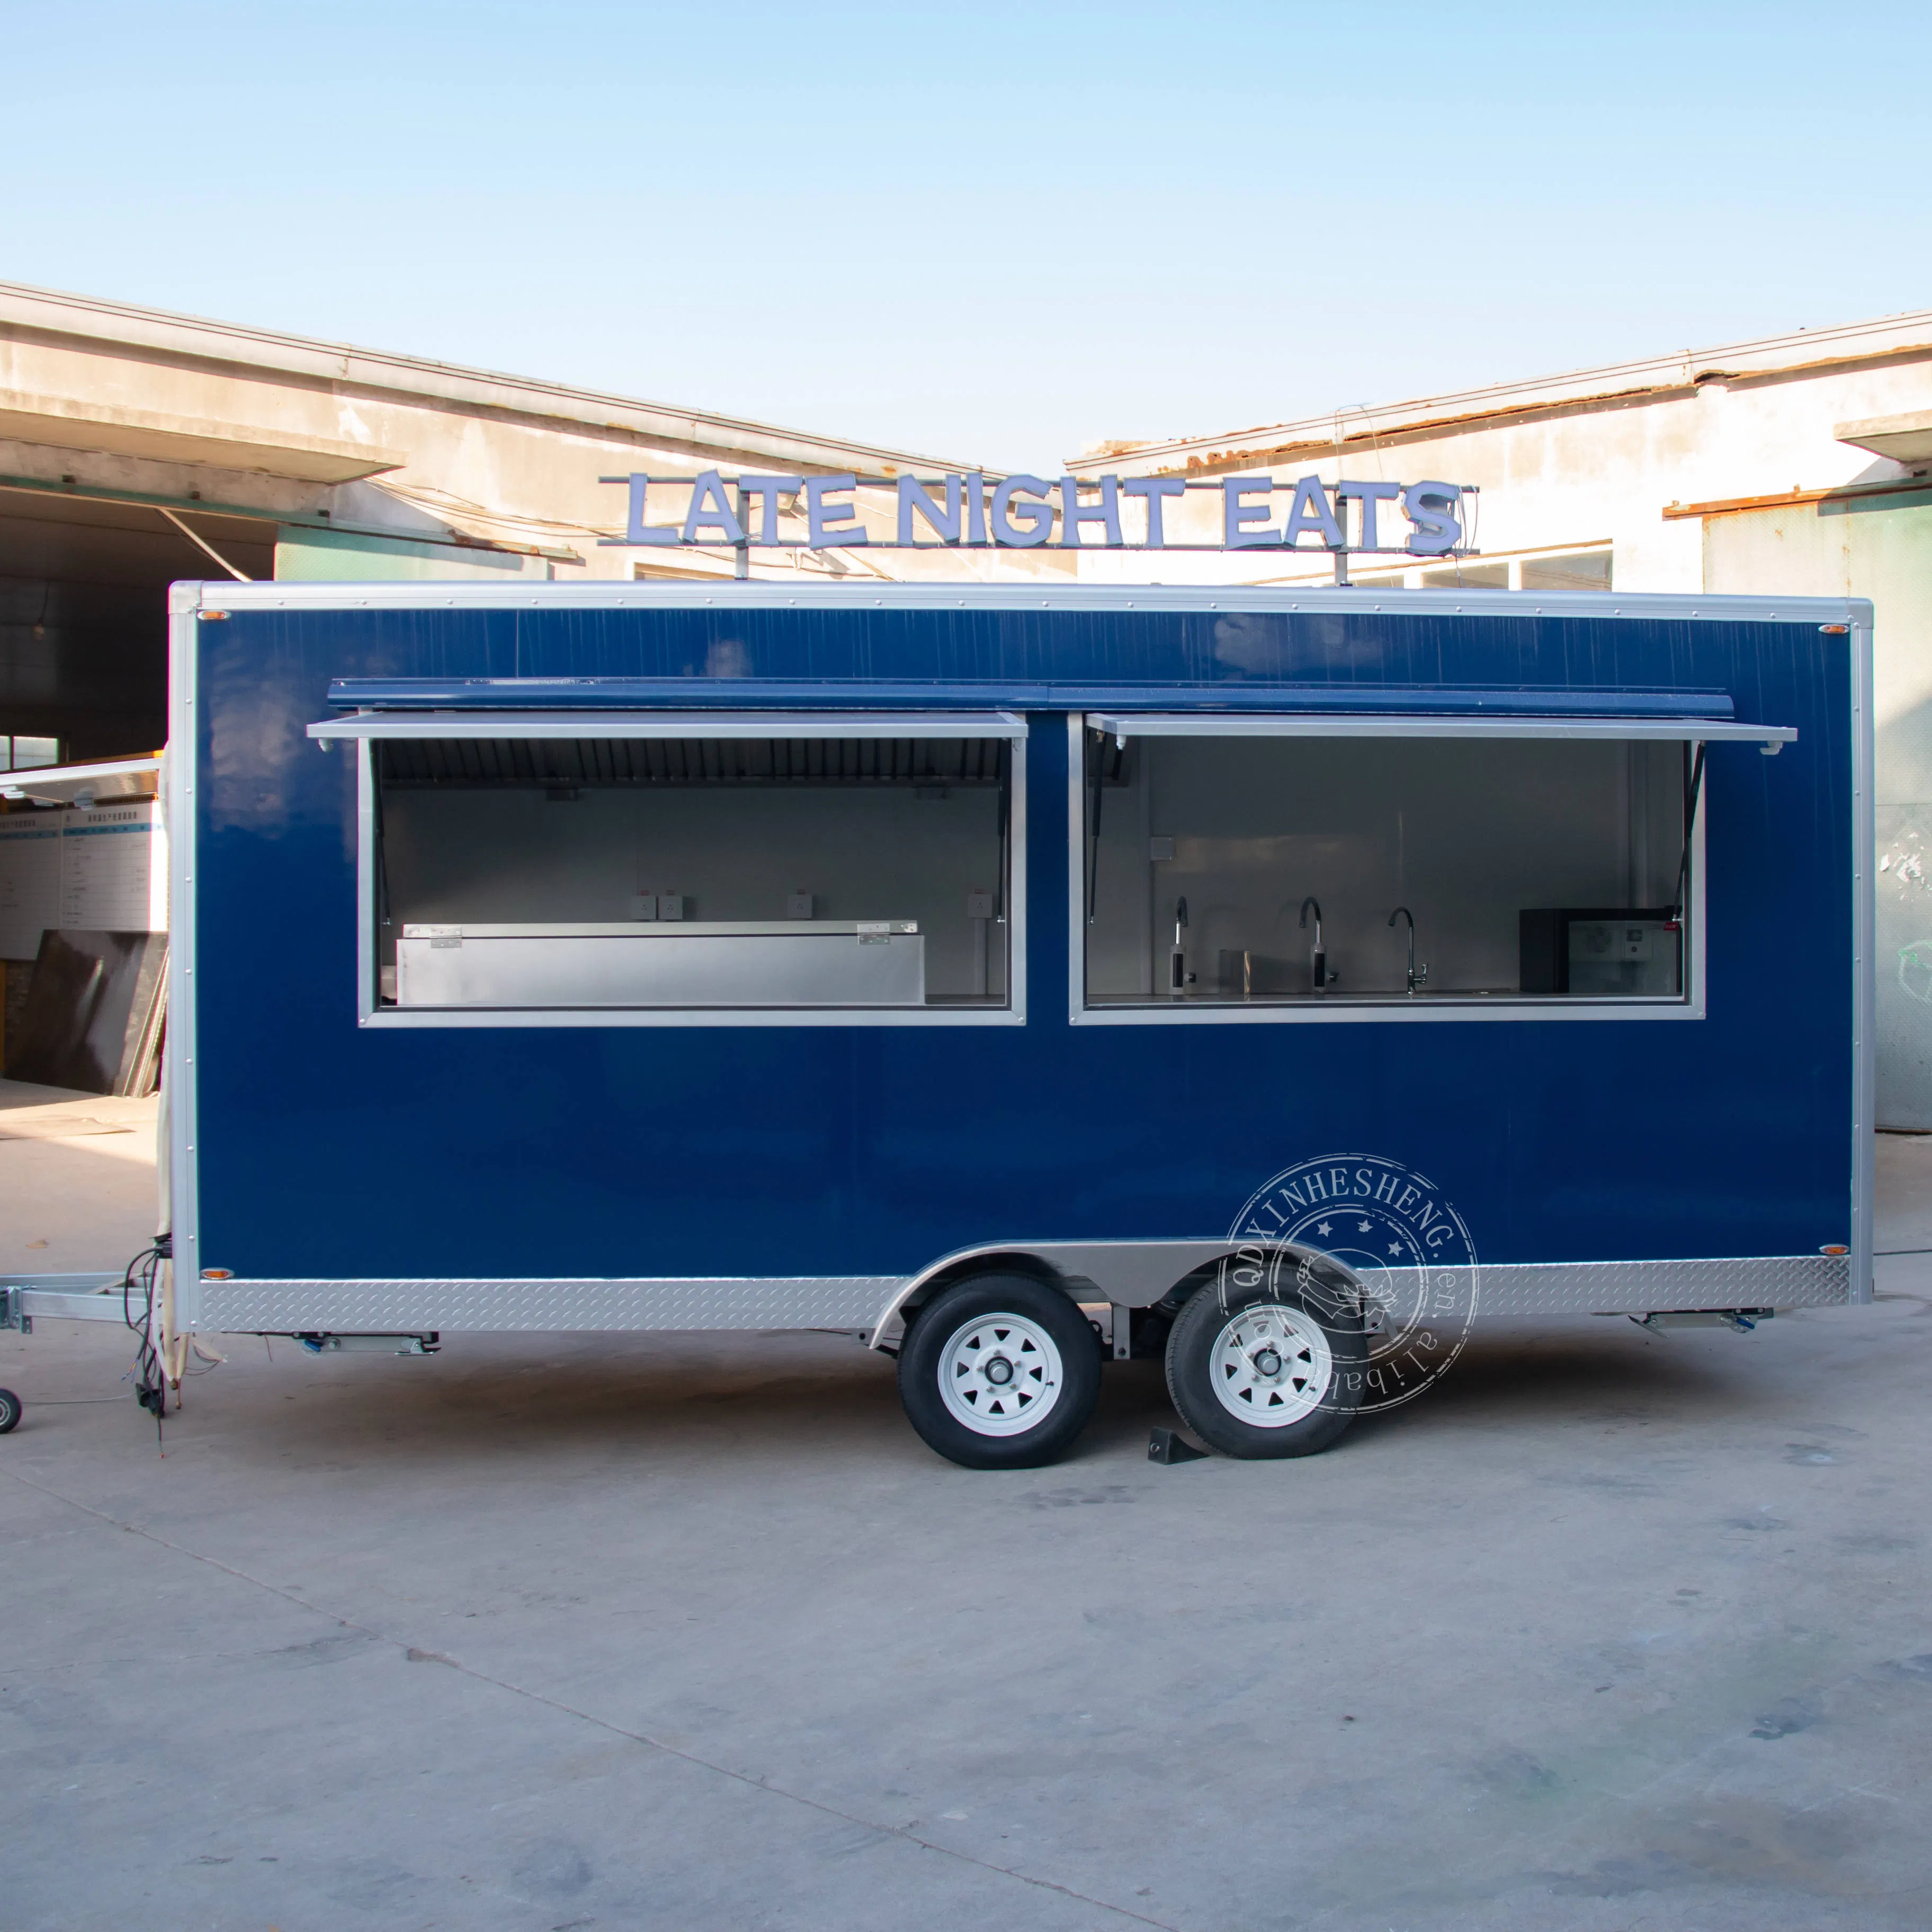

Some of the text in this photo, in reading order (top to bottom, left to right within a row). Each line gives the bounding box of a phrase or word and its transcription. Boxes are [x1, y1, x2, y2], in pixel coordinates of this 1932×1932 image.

[626, 469, 1462, 556] LATE NIGHT EATS
